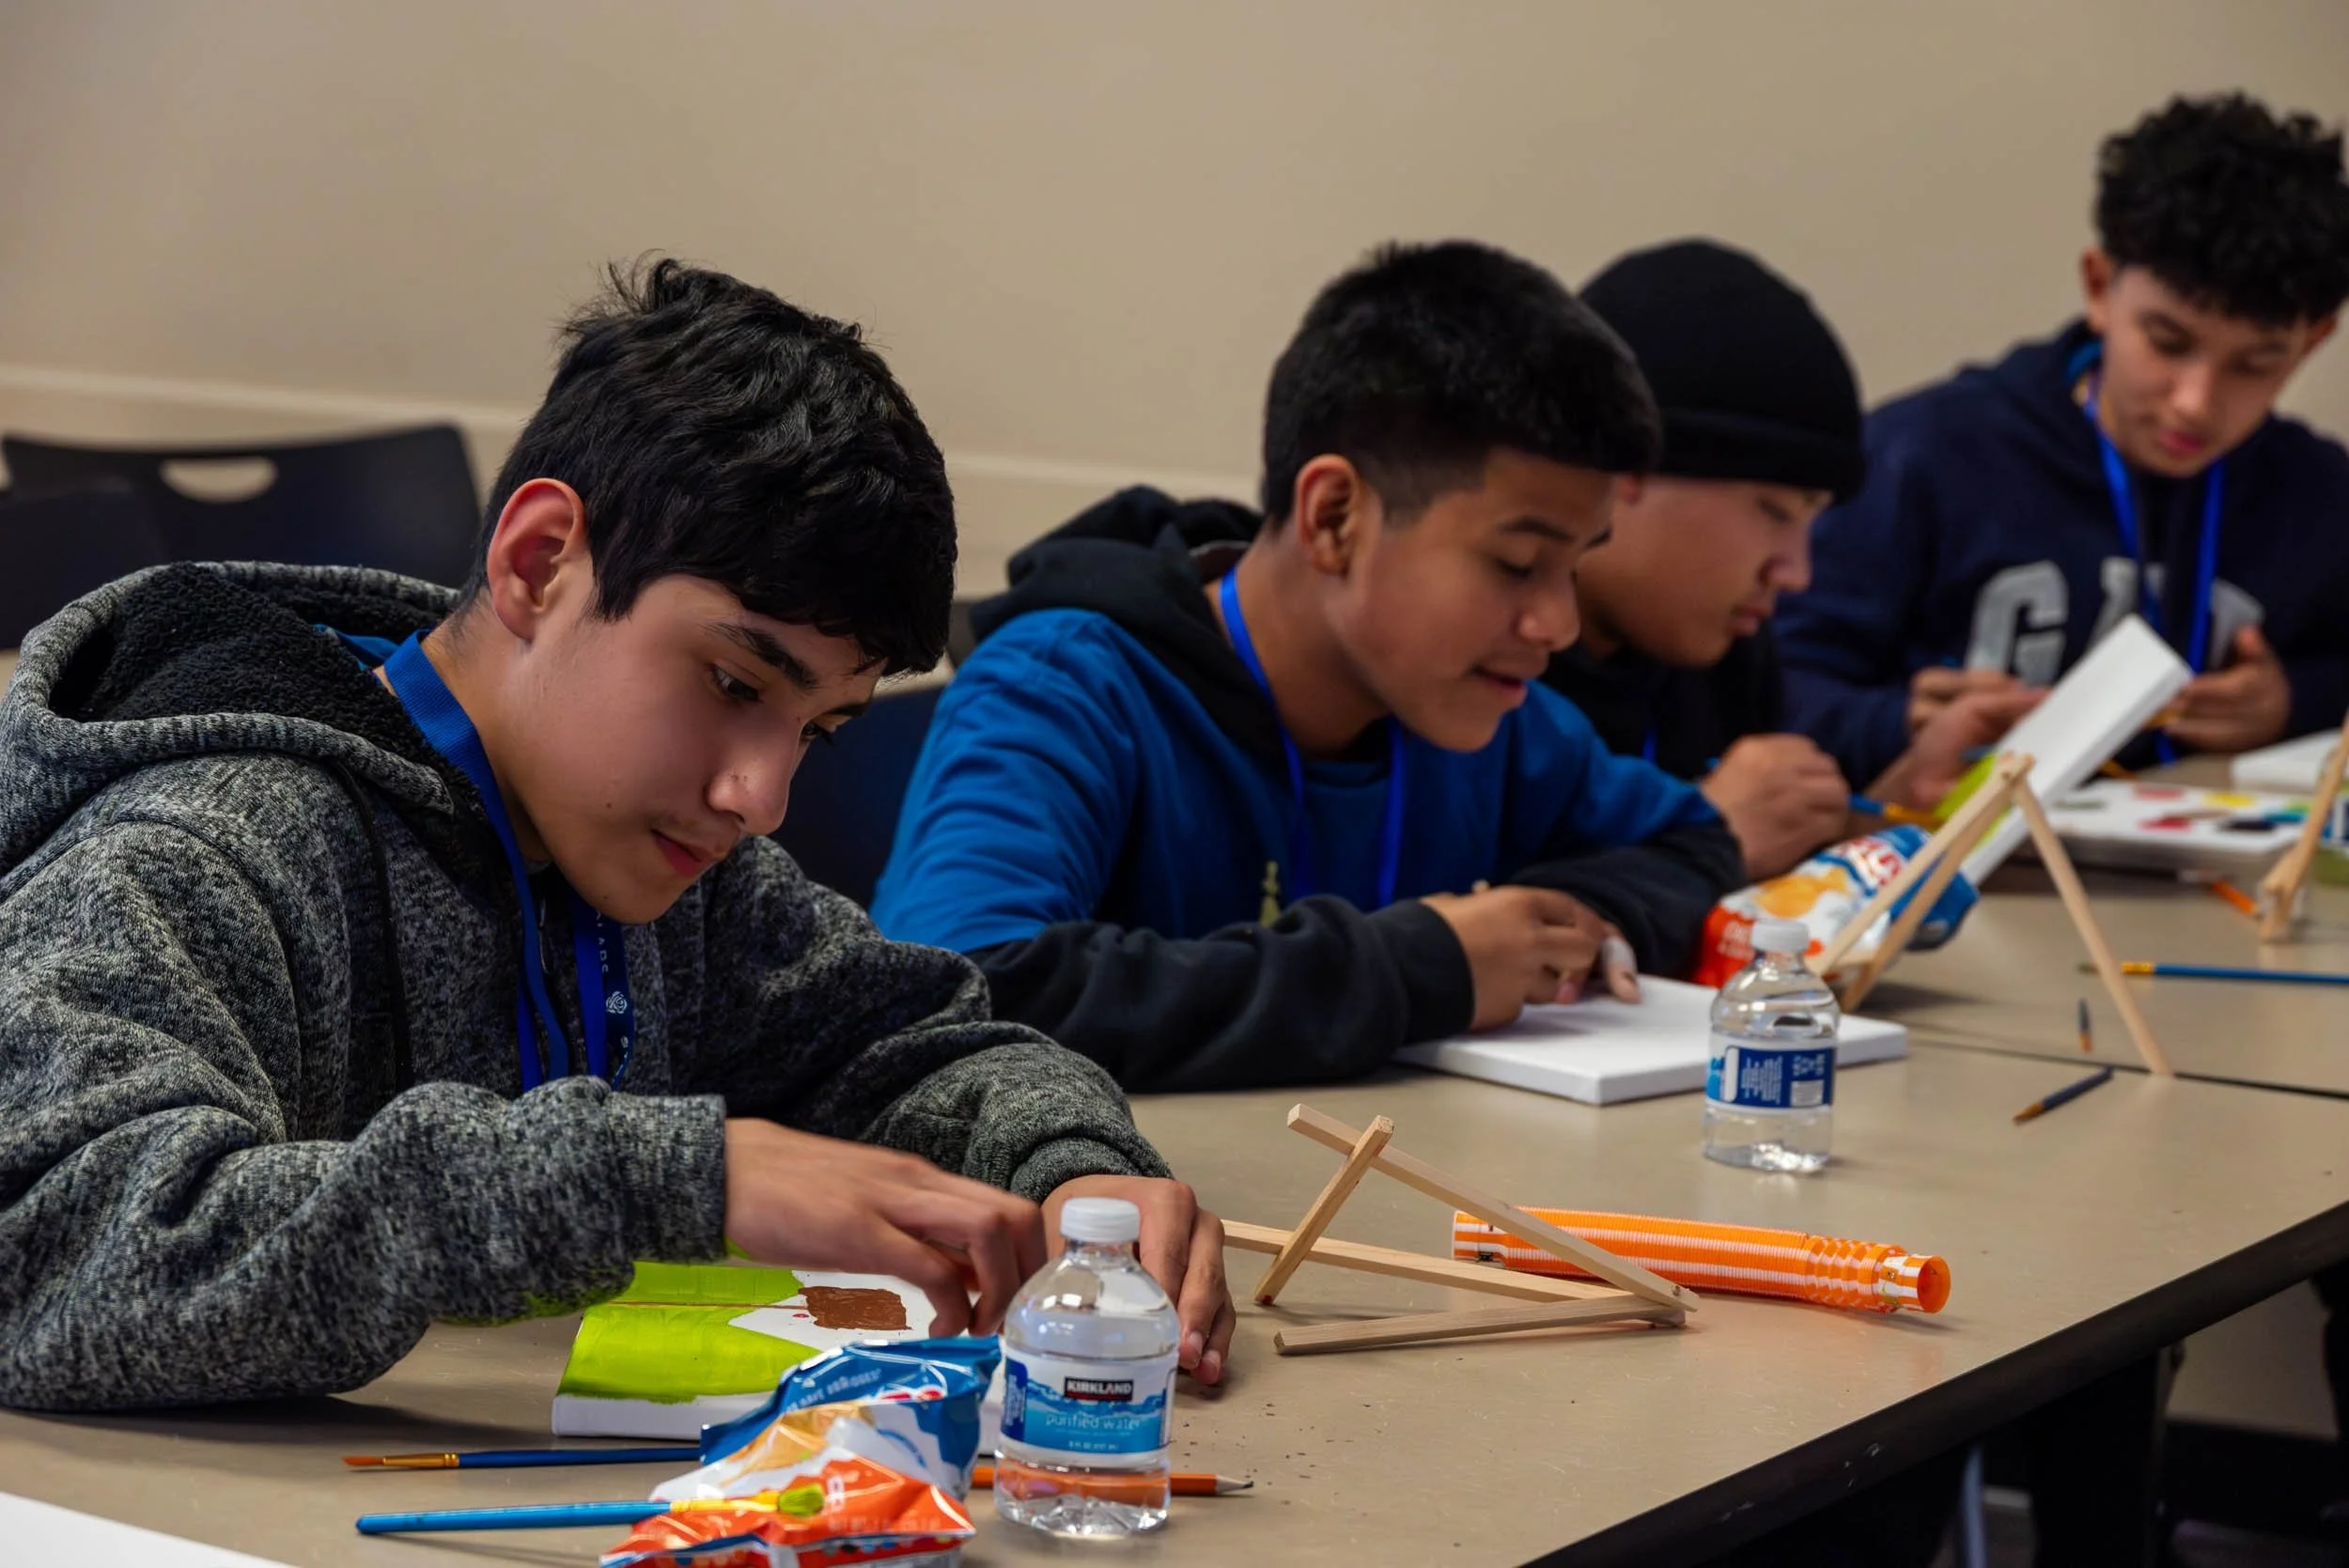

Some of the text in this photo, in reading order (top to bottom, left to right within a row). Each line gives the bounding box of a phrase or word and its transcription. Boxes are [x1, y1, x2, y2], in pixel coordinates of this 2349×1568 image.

[1067, 1380, 1131, 1395] KIRKLAND
[1046, 1414, 1140, 1430] purified water
